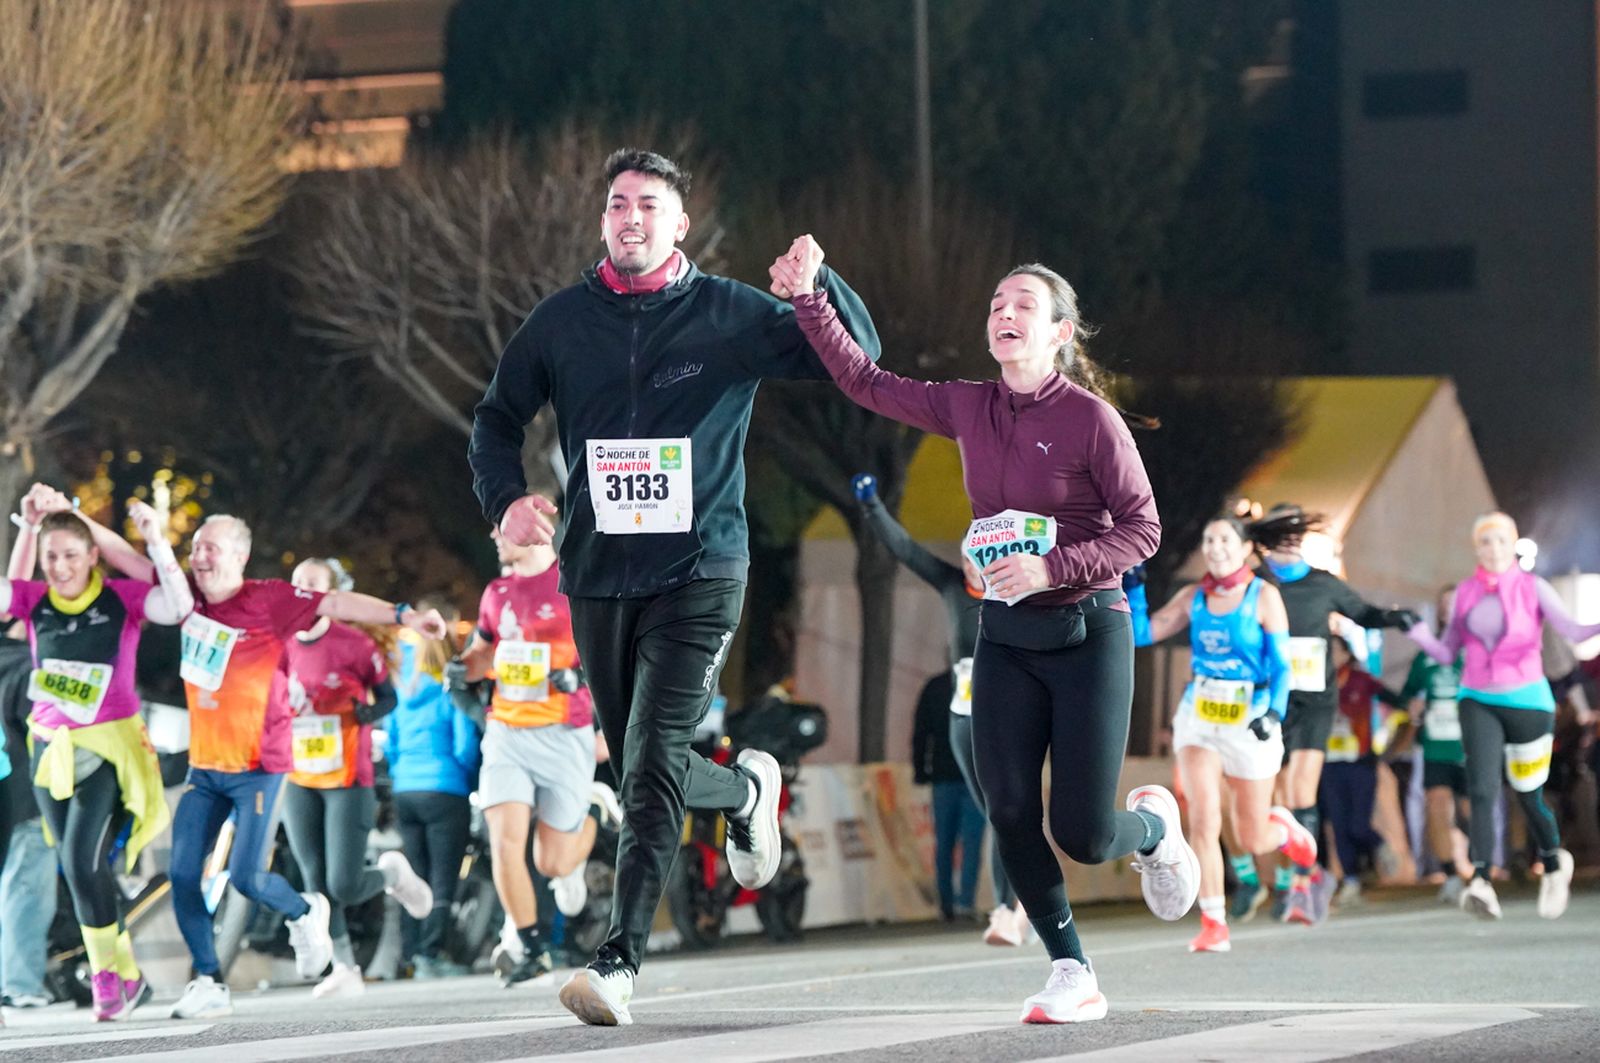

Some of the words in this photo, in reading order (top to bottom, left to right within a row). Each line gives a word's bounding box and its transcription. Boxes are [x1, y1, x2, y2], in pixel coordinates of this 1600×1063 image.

[607, 450, 635, 459] NOCHE
[639, 450, 650, 459] DE
[596, 462, 616, 472] SAN
[617, 460, 651, 472] ANTÓN
[606, 473, 669, 501] 3133
[980, 520, 1004, 532] NOCHE
[971, 535, 987, 547] SAN
[44, 673, 93, 700] 6838
